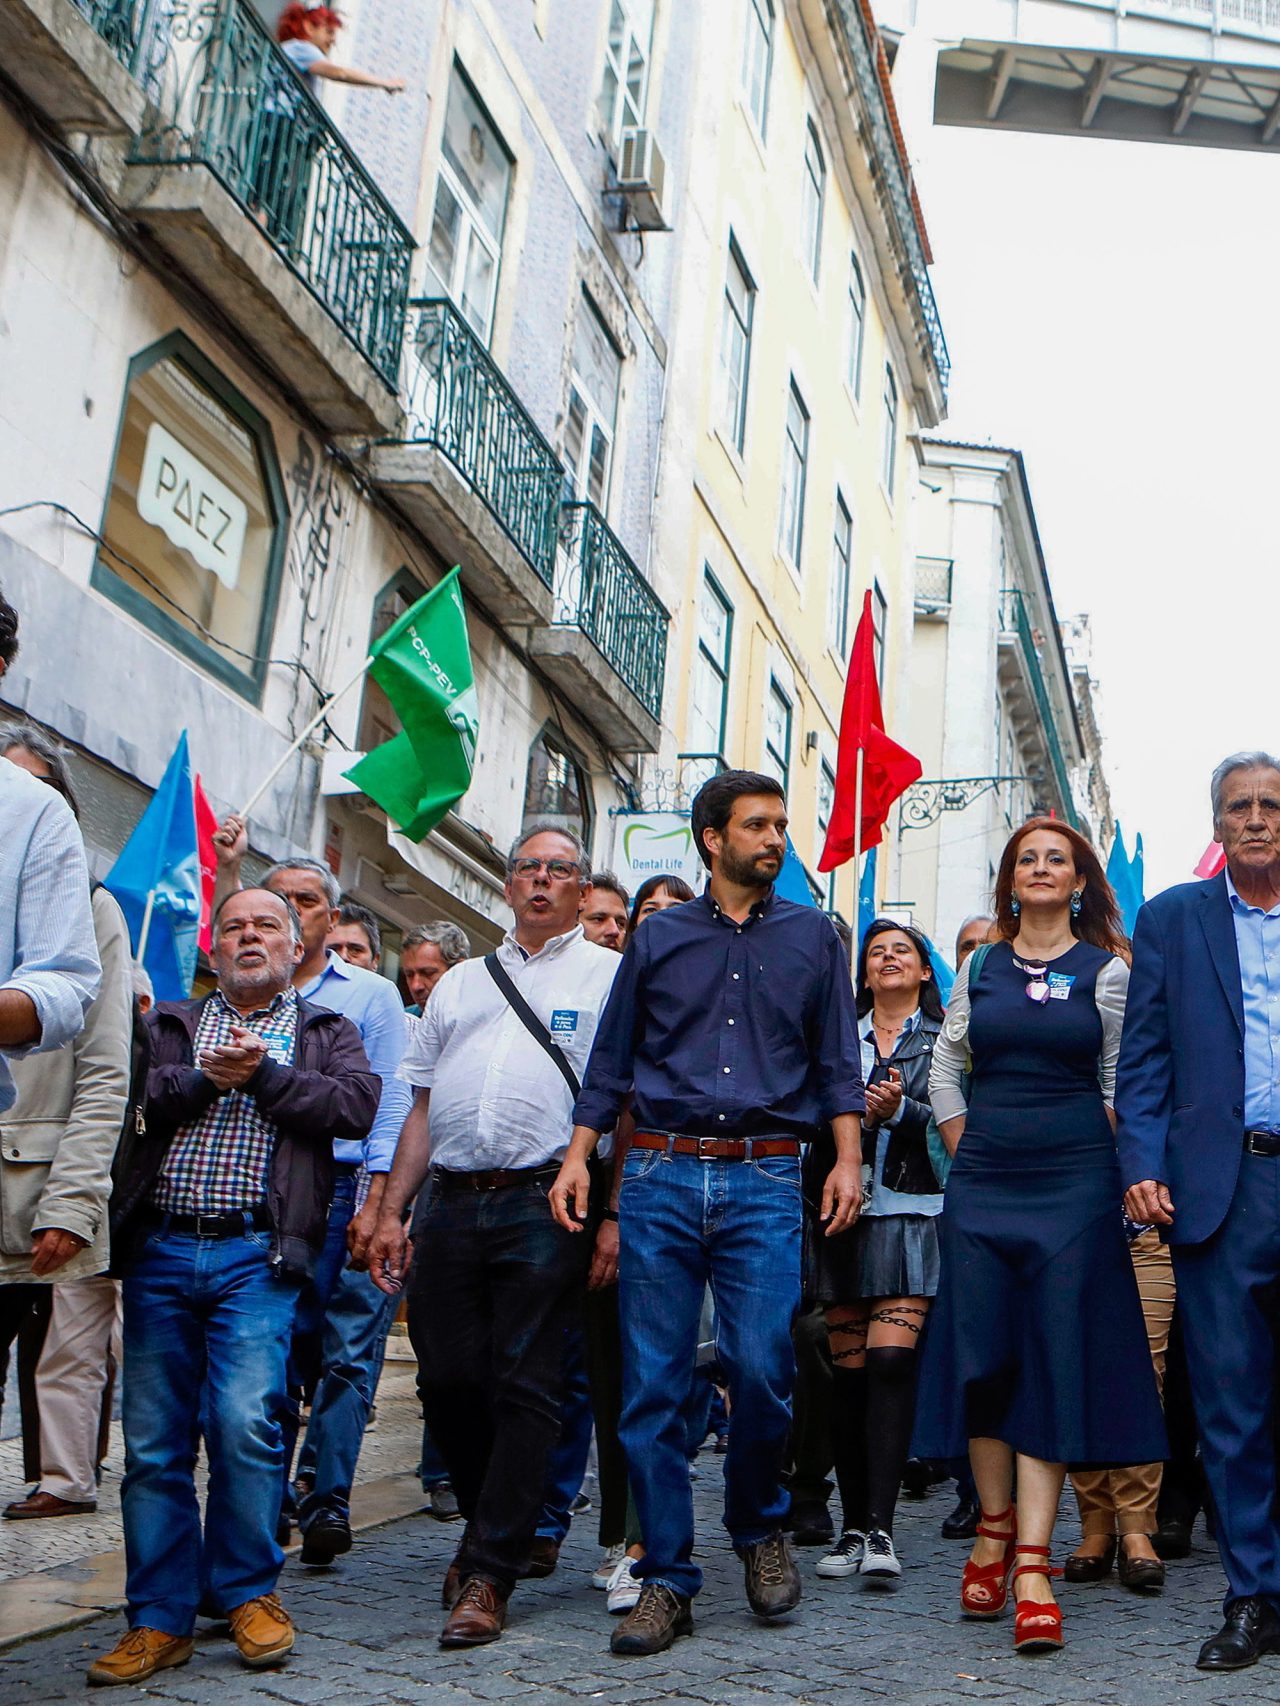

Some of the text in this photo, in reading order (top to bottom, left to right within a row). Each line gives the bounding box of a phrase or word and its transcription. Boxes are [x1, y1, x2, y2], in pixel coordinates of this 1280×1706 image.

[406, 625, 458, 696] PCP-PEV
[632, 858, 683, 870] Dental Life
